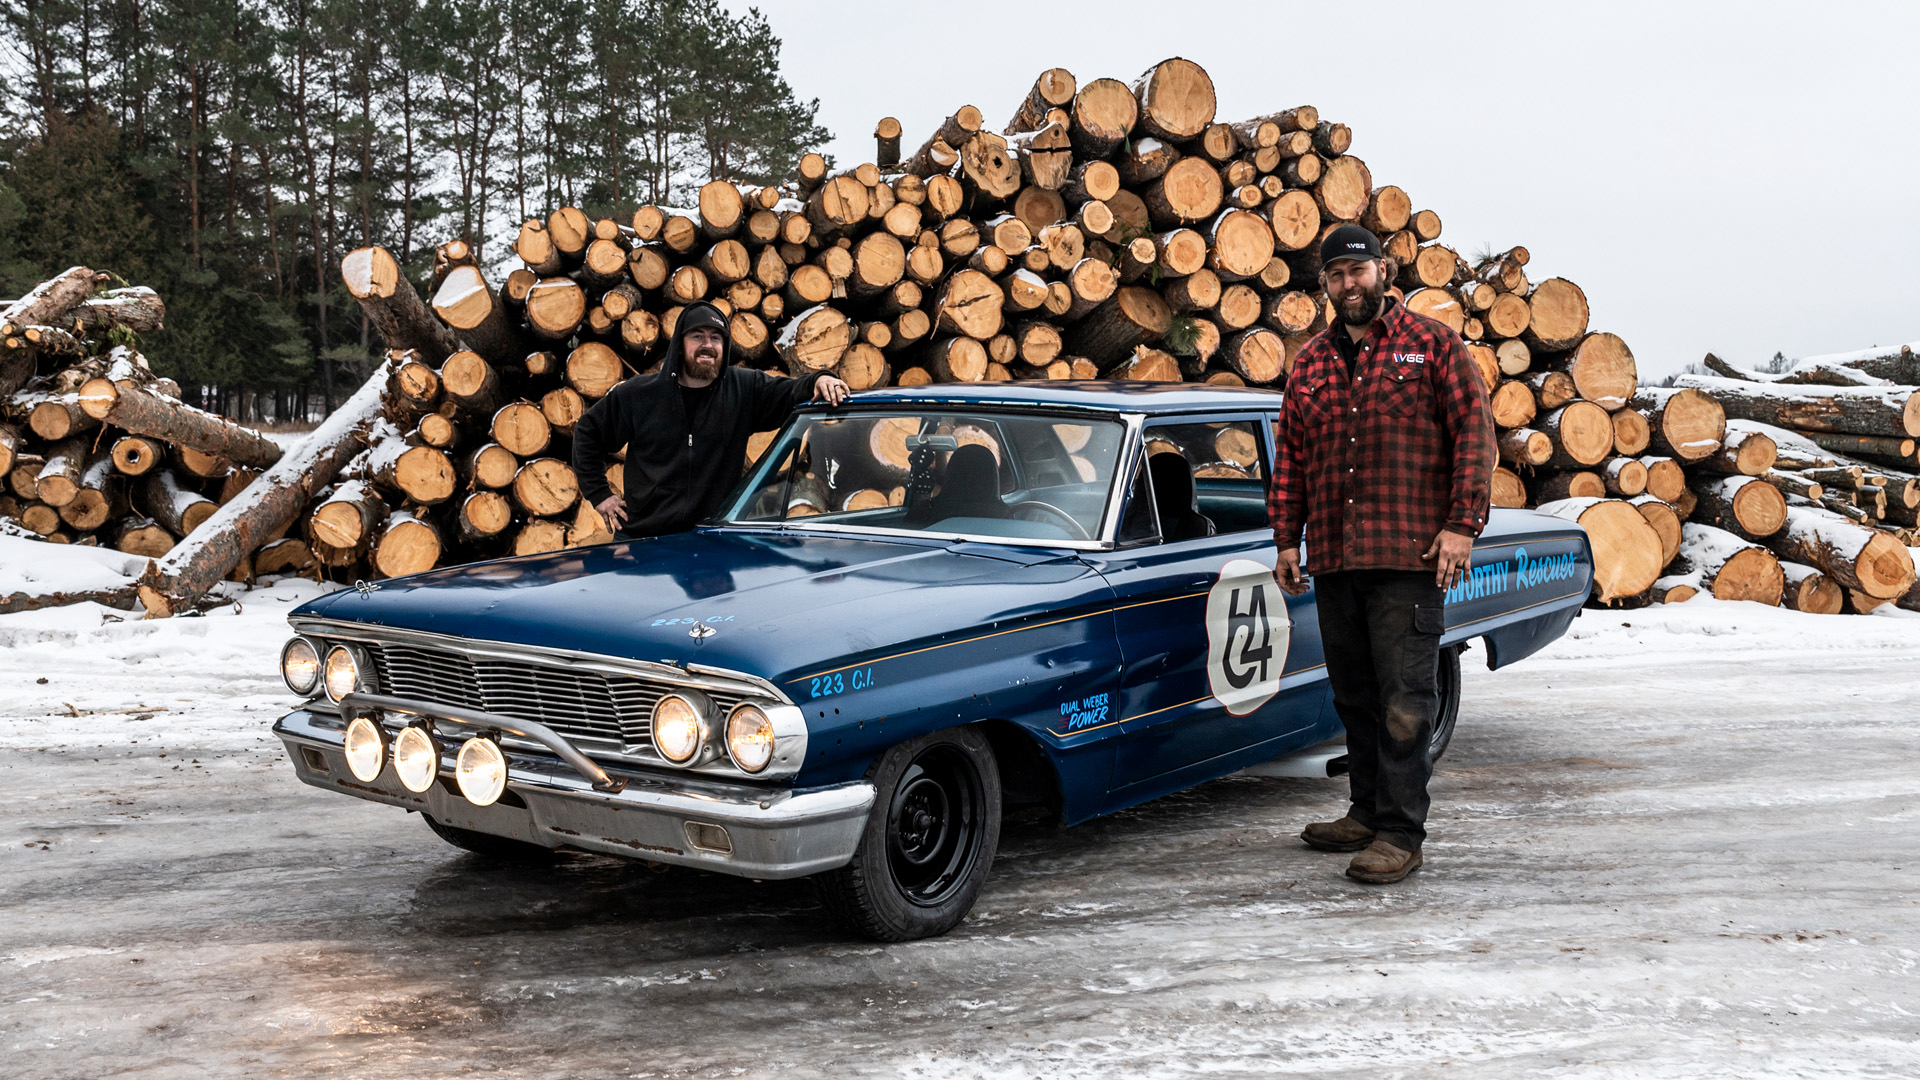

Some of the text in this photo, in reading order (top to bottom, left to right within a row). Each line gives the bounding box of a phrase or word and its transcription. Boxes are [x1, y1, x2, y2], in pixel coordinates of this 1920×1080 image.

[1444, 547, 1578, 606] WORTHY Rescues
[650, 617, 695, 627] 223
[811, 667, 875, 698] 223 C.I.
[1060, 692, 1109, 716] DUAL WEBER
[1068, 705, 1109, 730] POWER
